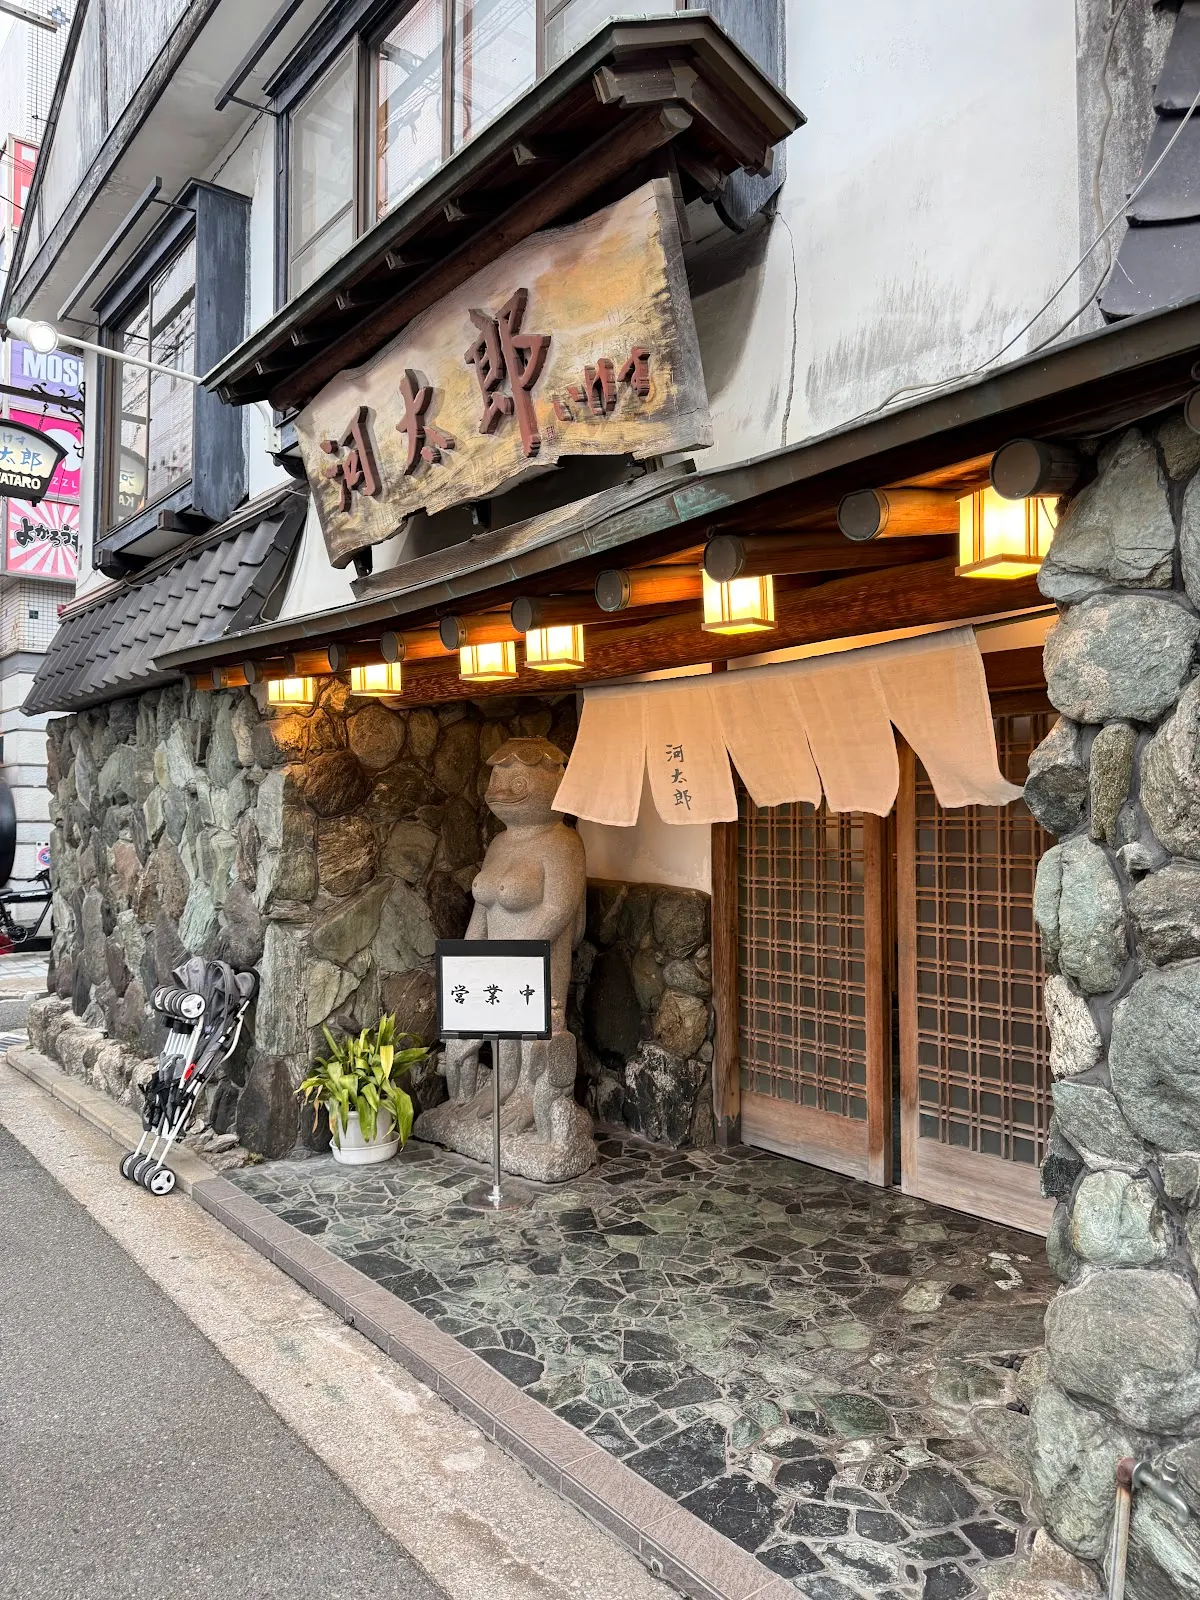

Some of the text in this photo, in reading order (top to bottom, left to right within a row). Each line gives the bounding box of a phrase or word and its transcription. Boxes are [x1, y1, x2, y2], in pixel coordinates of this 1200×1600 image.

[319, 287, 552, 513] 河太郎
[0, 471, 41, 490] ATARO
[665, 744, 692, 811] 河太郎
[451, 983, 536, 1006] 営業中
